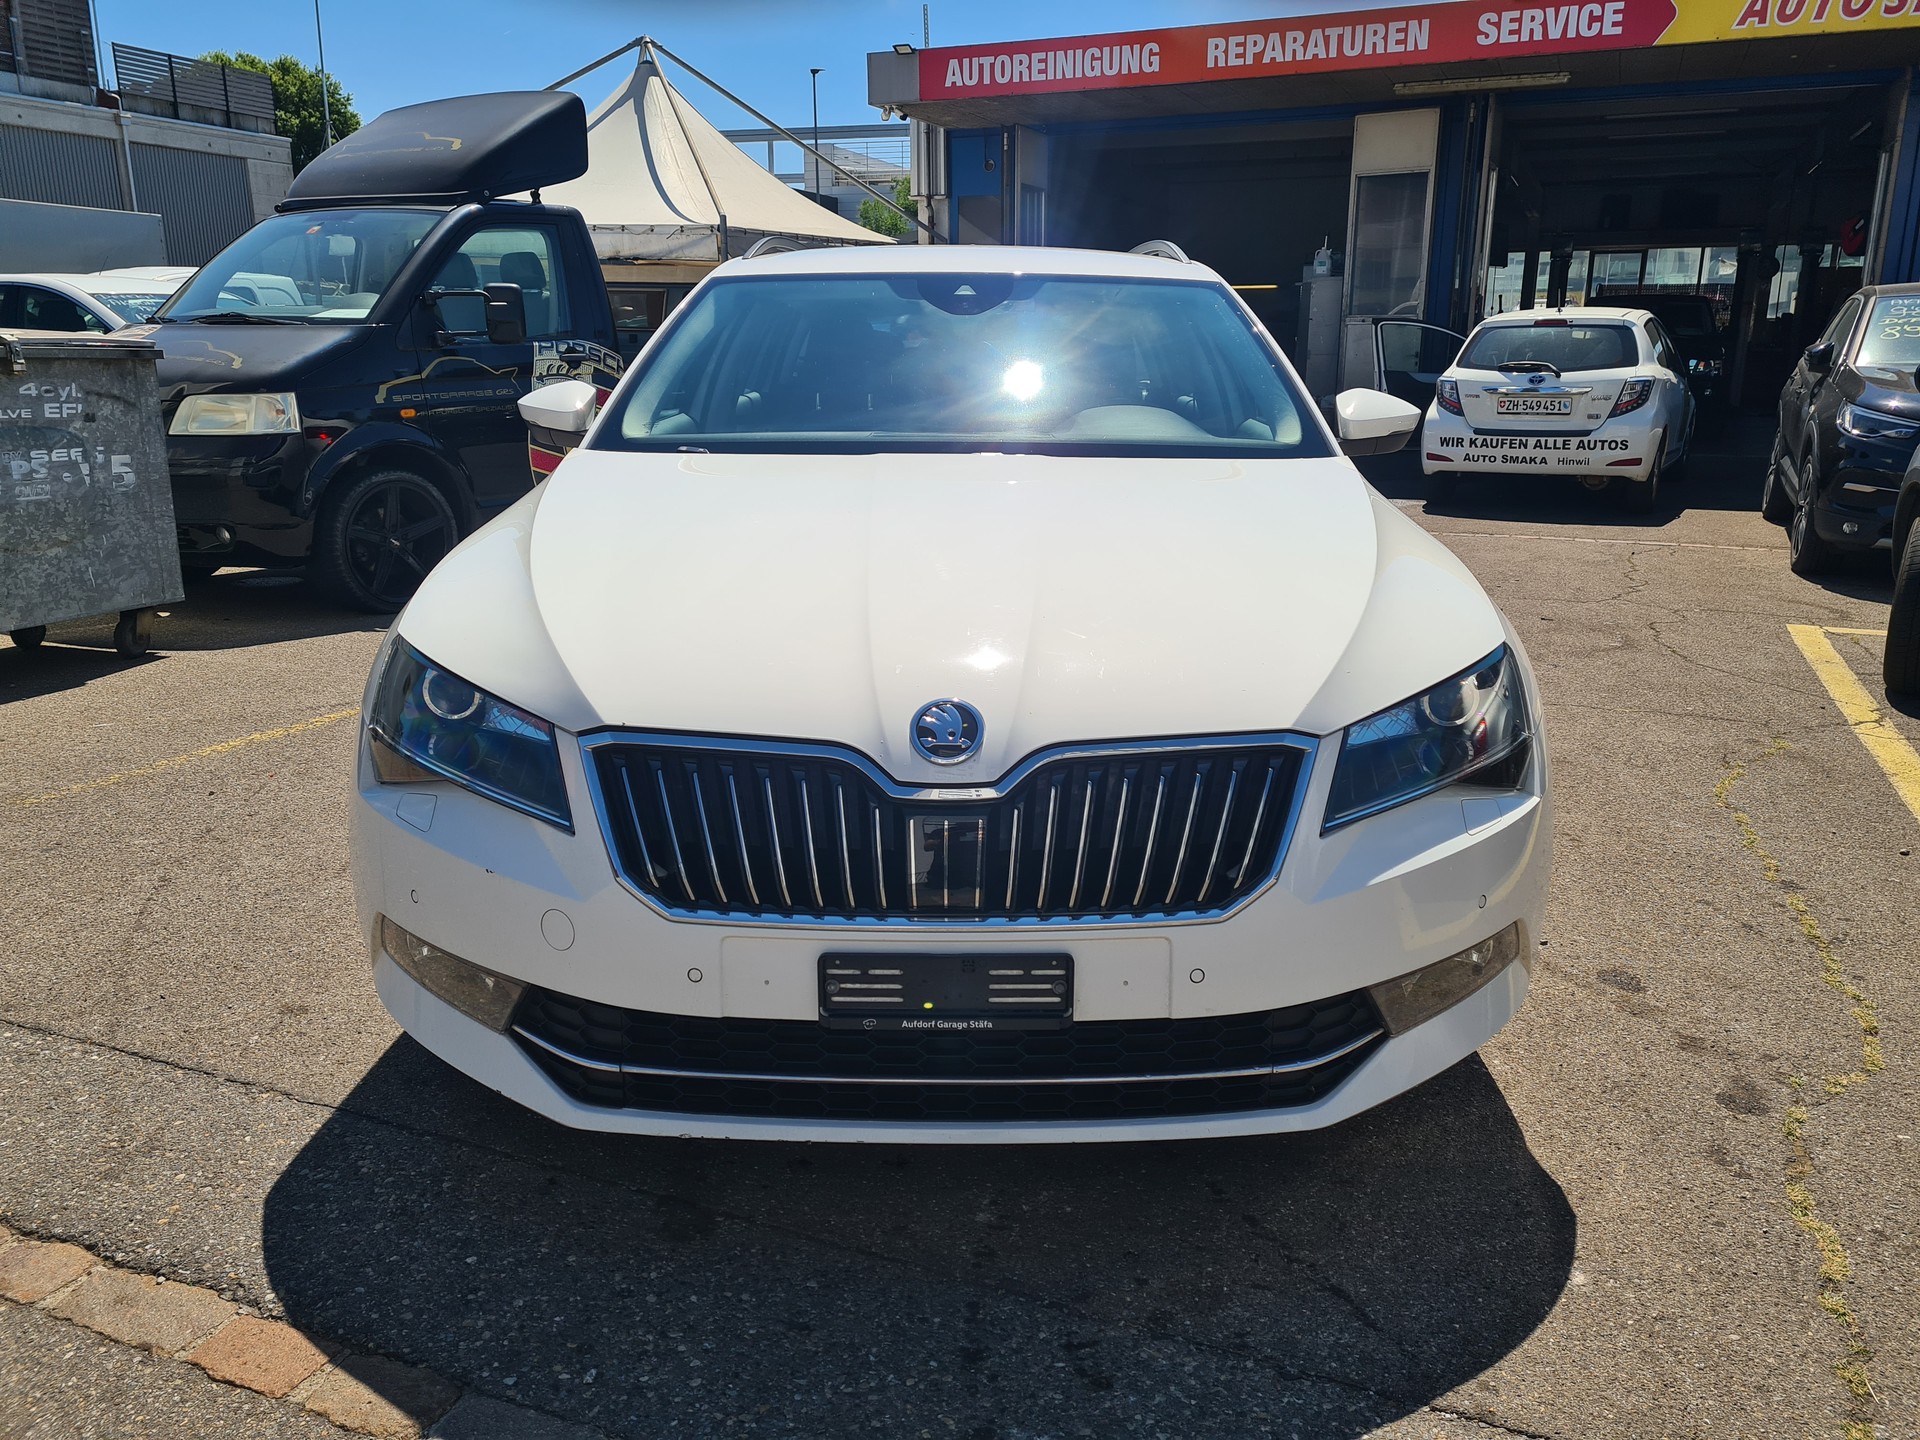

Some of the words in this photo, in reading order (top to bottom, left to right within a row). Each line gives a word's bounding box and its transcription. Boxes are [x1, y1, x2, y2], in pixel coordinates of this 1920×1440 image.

[944, 42, 1160, 88] AUTOREINIGUNG
[1206, 18, 1430, 68] REPARATUREN
[1476, 1, 1623, 45] SERVICE
[1439, 436, 1465, 448] WIR
[1468, 437, 1528, 450] KAUFEN
[1533, 438, 1571, 450] ALLE
[1575, 439, 1629, 451] AUTOS
[1463, 452, 1497, 464] AUTO
[1501, 454, 1548, 465] SMAKA
[1557, 457, 1590, 466] Hinwil
[901, 1020, 936, 1028] Aufdorf
[936, 1020, 968, 1030] Garage
[969, 1020, 993, 1028] Stäfa
